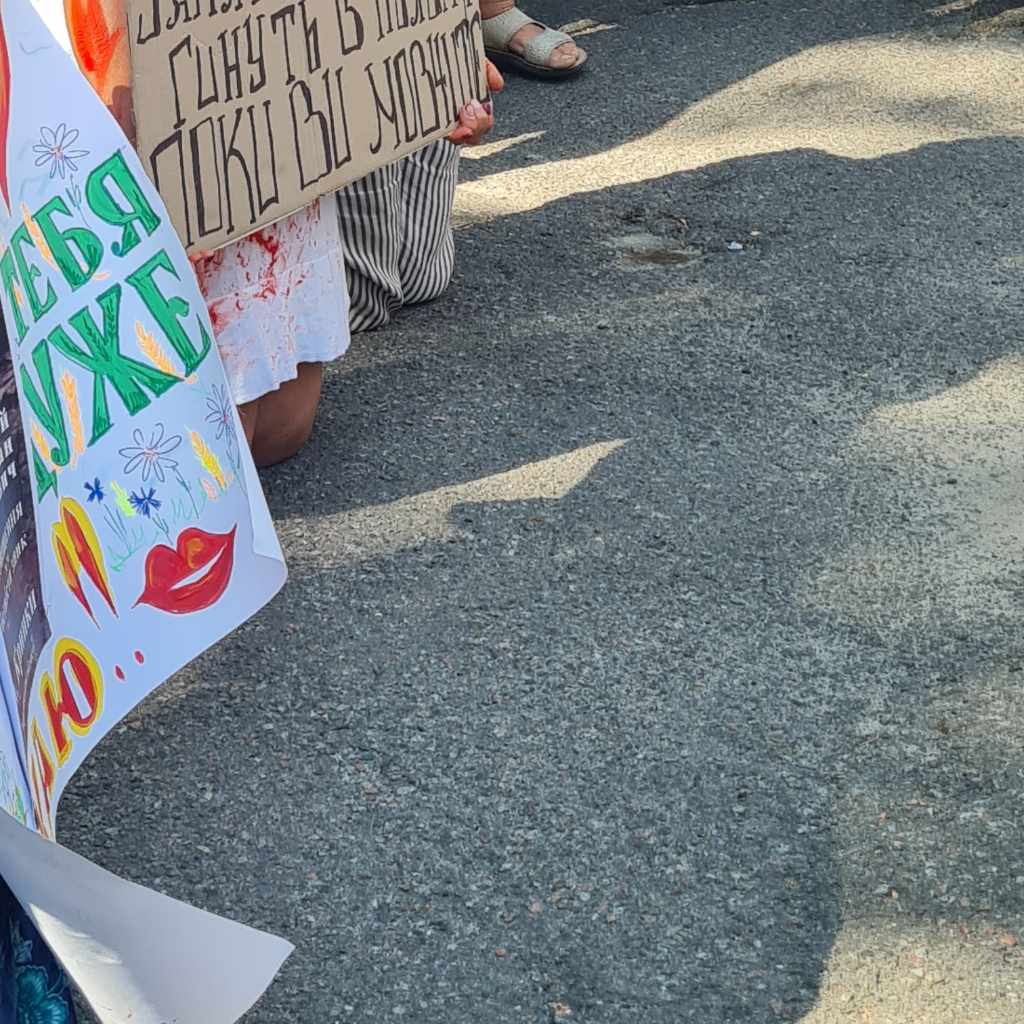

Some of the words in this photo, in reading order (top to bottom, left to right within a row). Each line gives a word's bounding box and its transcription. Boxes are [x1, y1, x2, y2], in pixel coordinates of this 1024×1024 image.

[0, 148, 163, 346] ТЕБЯ
[150, 99, 280, 248] ПОКИ
[288, 66, 353, 191] ВИ
[19, 250, 213, 468] УЖЕ
